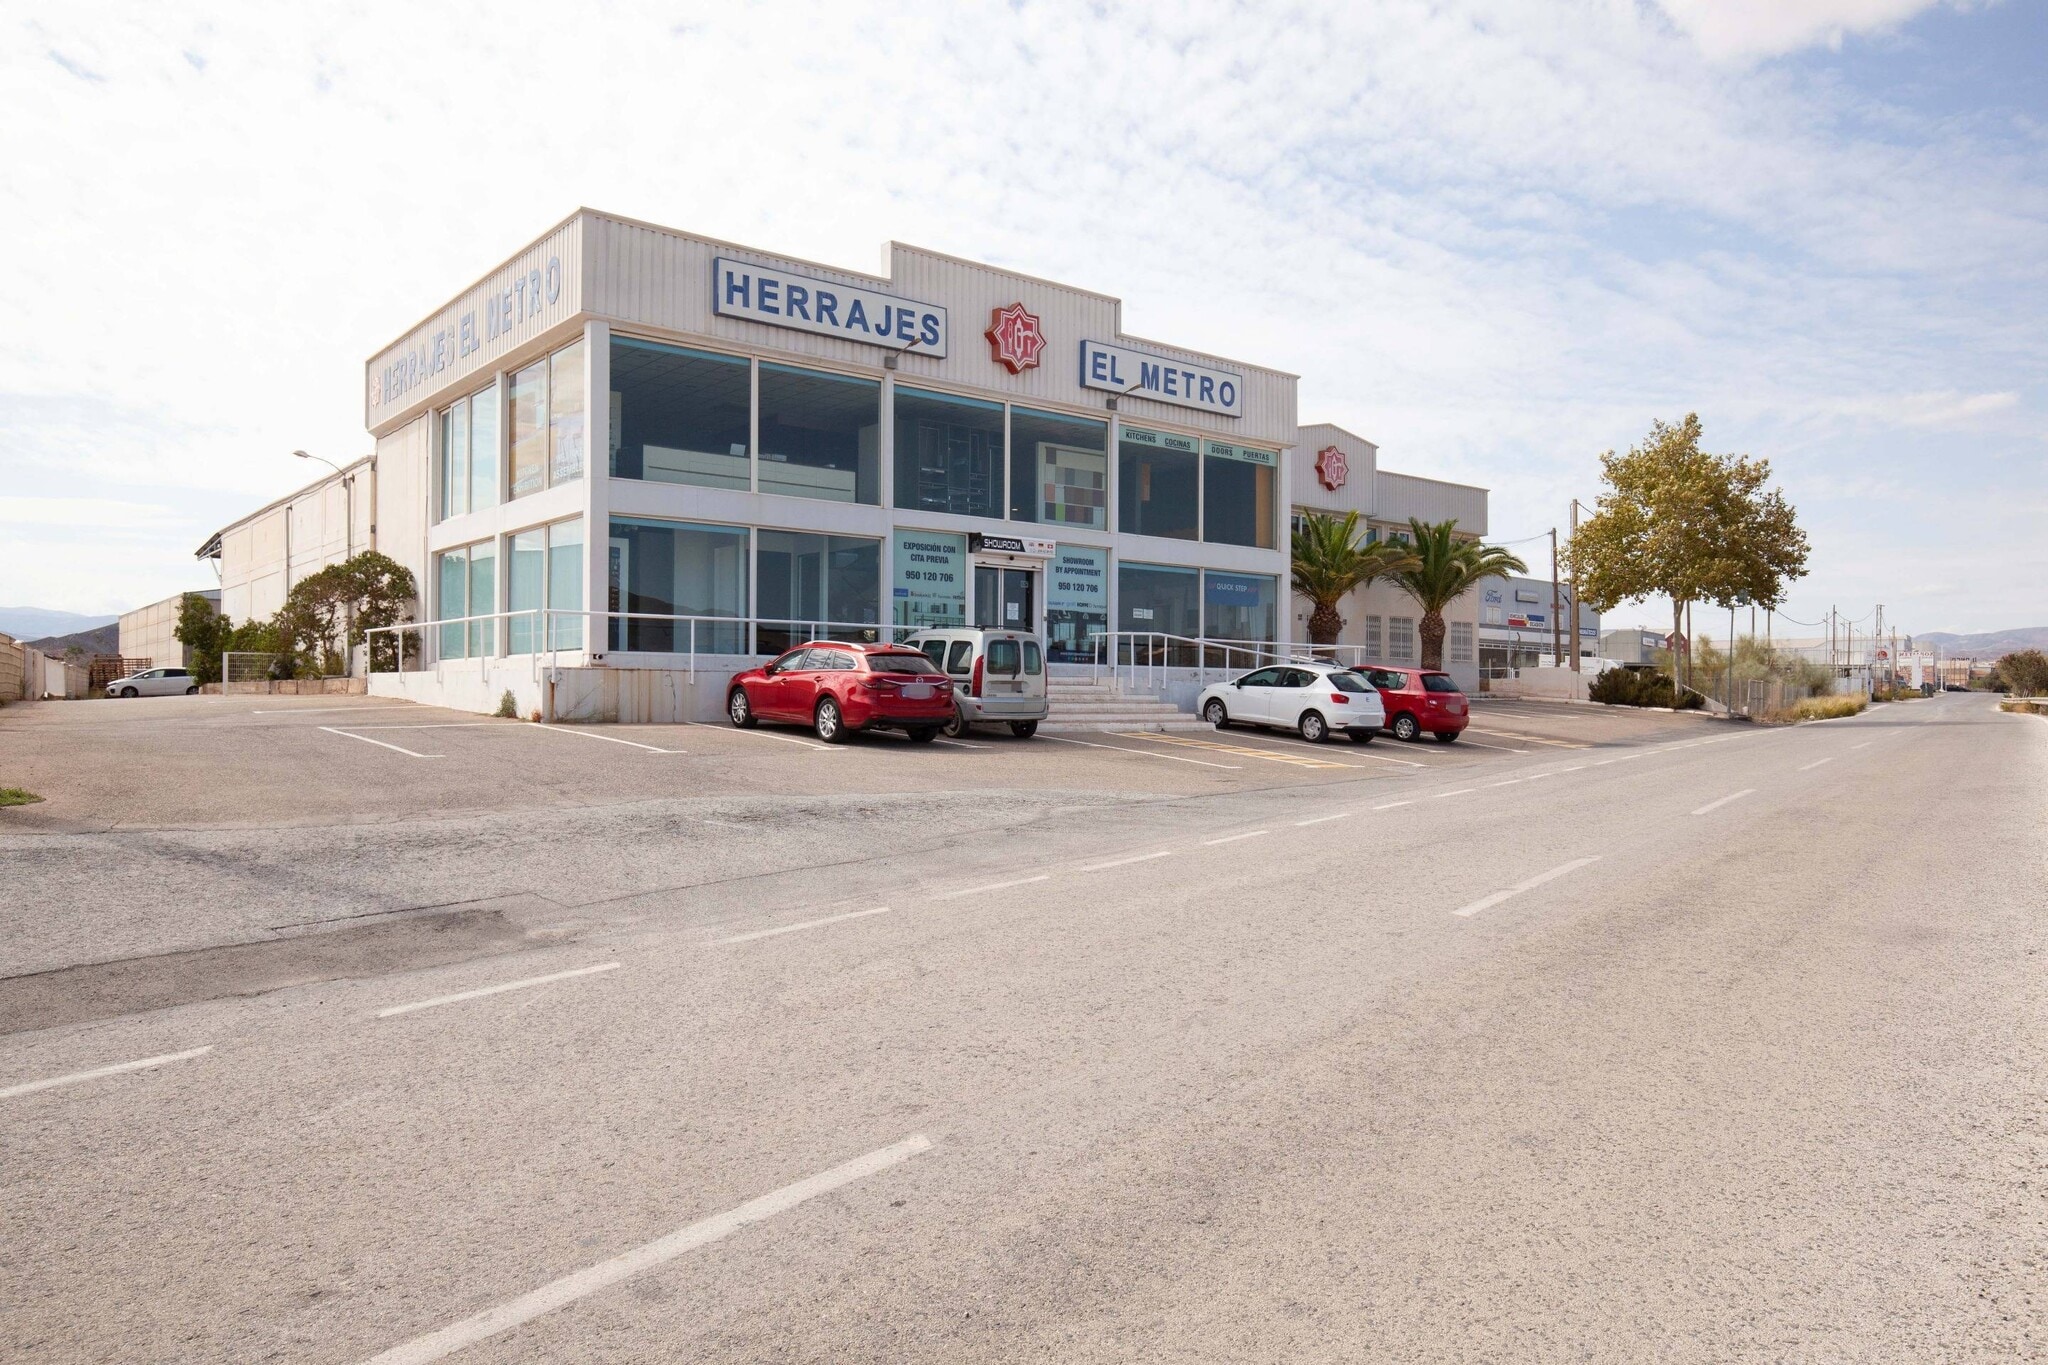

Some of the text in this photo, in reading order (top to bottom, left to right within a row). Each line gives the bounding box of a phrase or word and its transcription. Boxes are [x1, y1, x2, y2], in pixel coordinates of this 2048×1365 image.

[725, 270, 942, 347] HERRAJES
[384, 256, 561, 405] HERRAJES EL METRO
[1091, 351, 1236, 408] EL METRO
[1125, 431, 1191, 449] KITCHENS COCINAS
[1211, 446, 1270, 461] DOORS PUERTAS
[903, 541, 956, 554] EXPOSICIÓN CON
[983, 538, 1021, 550] SHOWROOM
[910, 553, 949, 564] CITA PREVIA
[1062, 556, 1095, 566] SHOWROOM
[905, 570, 954, 582] 950 120 706
[1064, 567, 1101, 577] APPOINTMENT
[1058, 582, 1099, 593] 950 120 706
[1216, 583, 1248, 592] QUICK STEP
[1484, 589, 1503, 604] Ford
